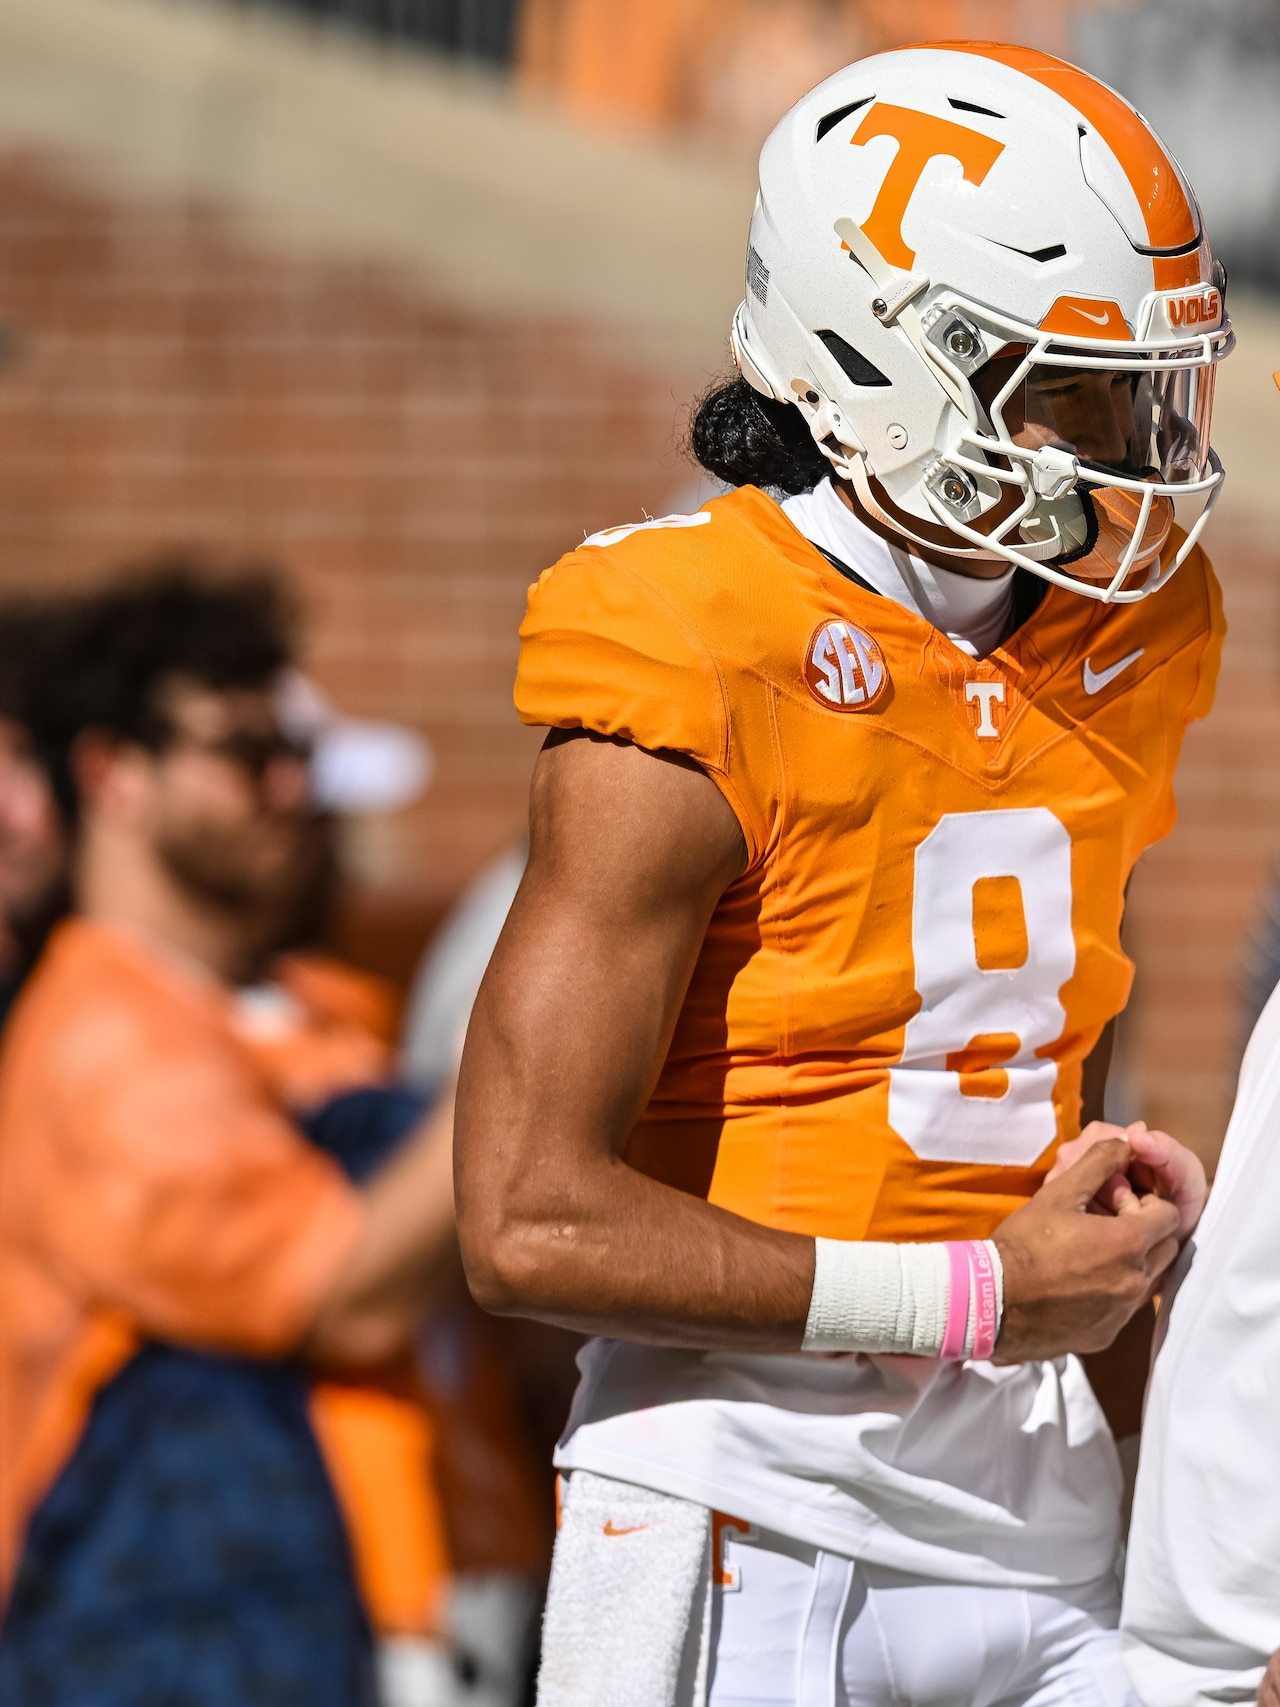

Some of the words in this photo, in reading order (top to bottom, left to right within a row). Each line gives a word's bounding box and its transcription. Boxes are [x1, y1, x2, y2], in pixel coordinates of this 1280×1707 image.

[841, 102, 1006, 271] T
[1167, 291, 1218, 327] VOLS
[811, 622, 882, 703] SEC
[965, 682, 1004, 737] T
[888, 807, 1076, 1167] 8
[978, 1281, 994, 1330] Team
